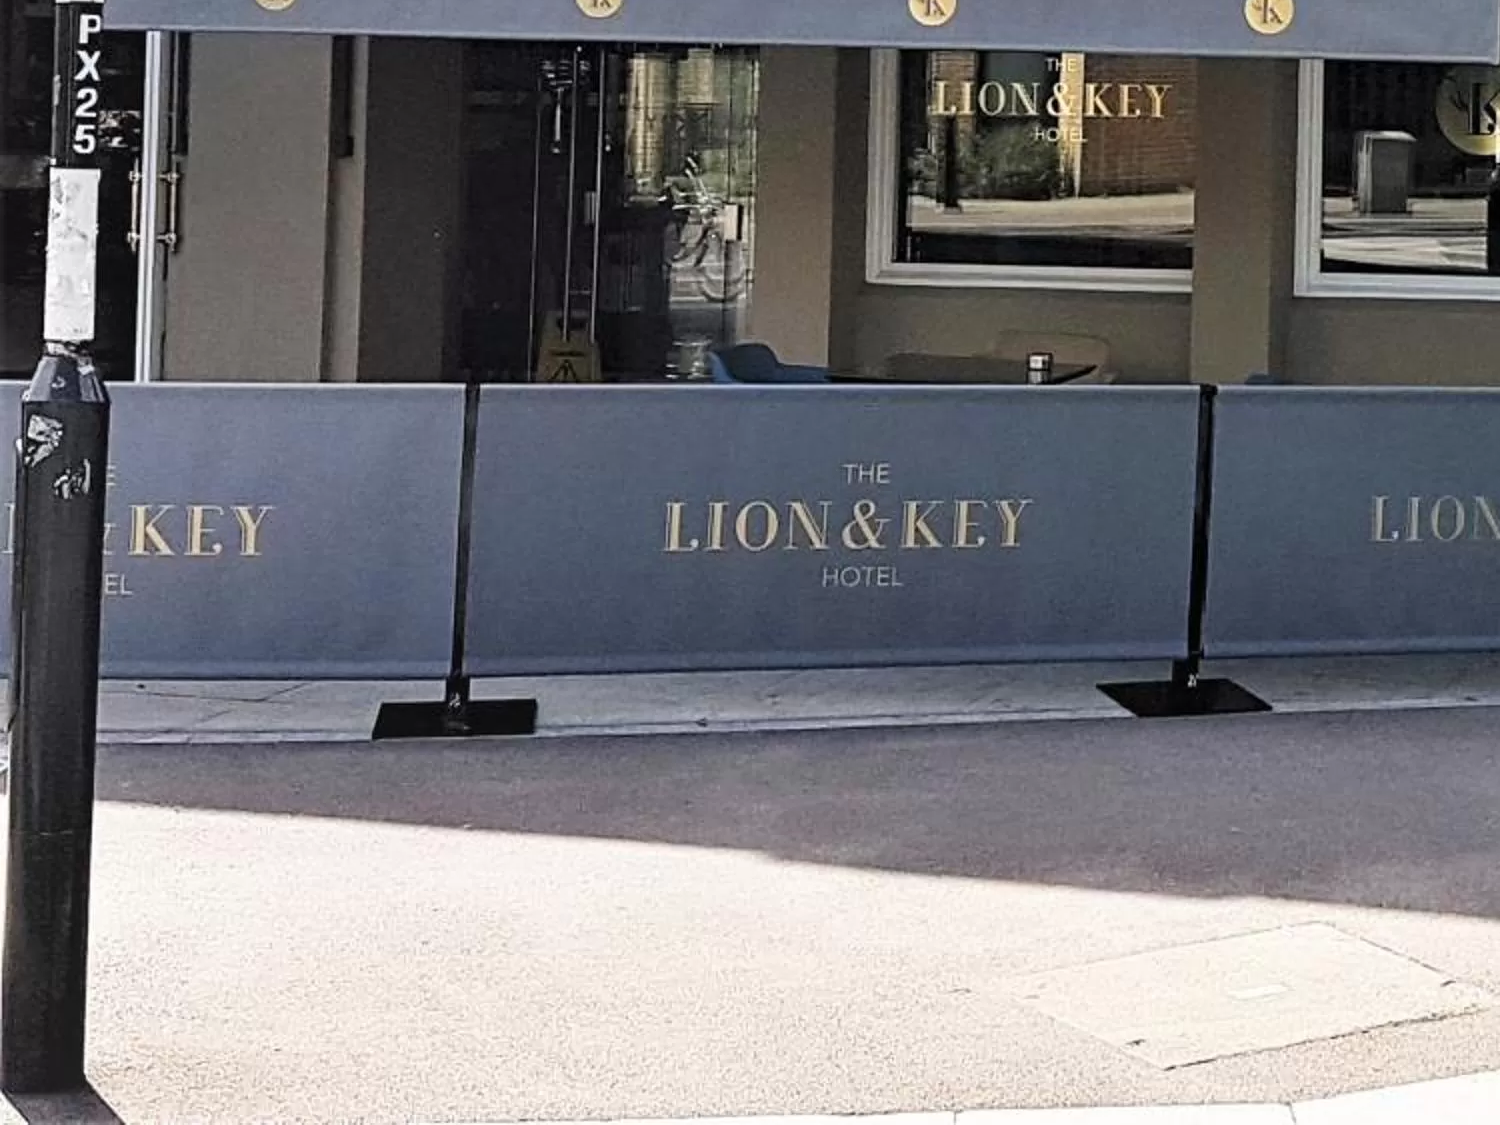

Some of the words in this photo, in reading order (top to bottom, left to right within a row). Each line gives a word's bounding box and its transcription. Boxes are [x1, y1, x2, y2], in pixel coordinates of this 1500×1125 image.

[1044, 57, 1077, 73] THE
[1033, 127, 1089, 143] HOTEL
[842, 463, 892, 485] THE
[662, 497, 1035, 553] LION&KEY
[821, 566, 904, 589] HOTEL
